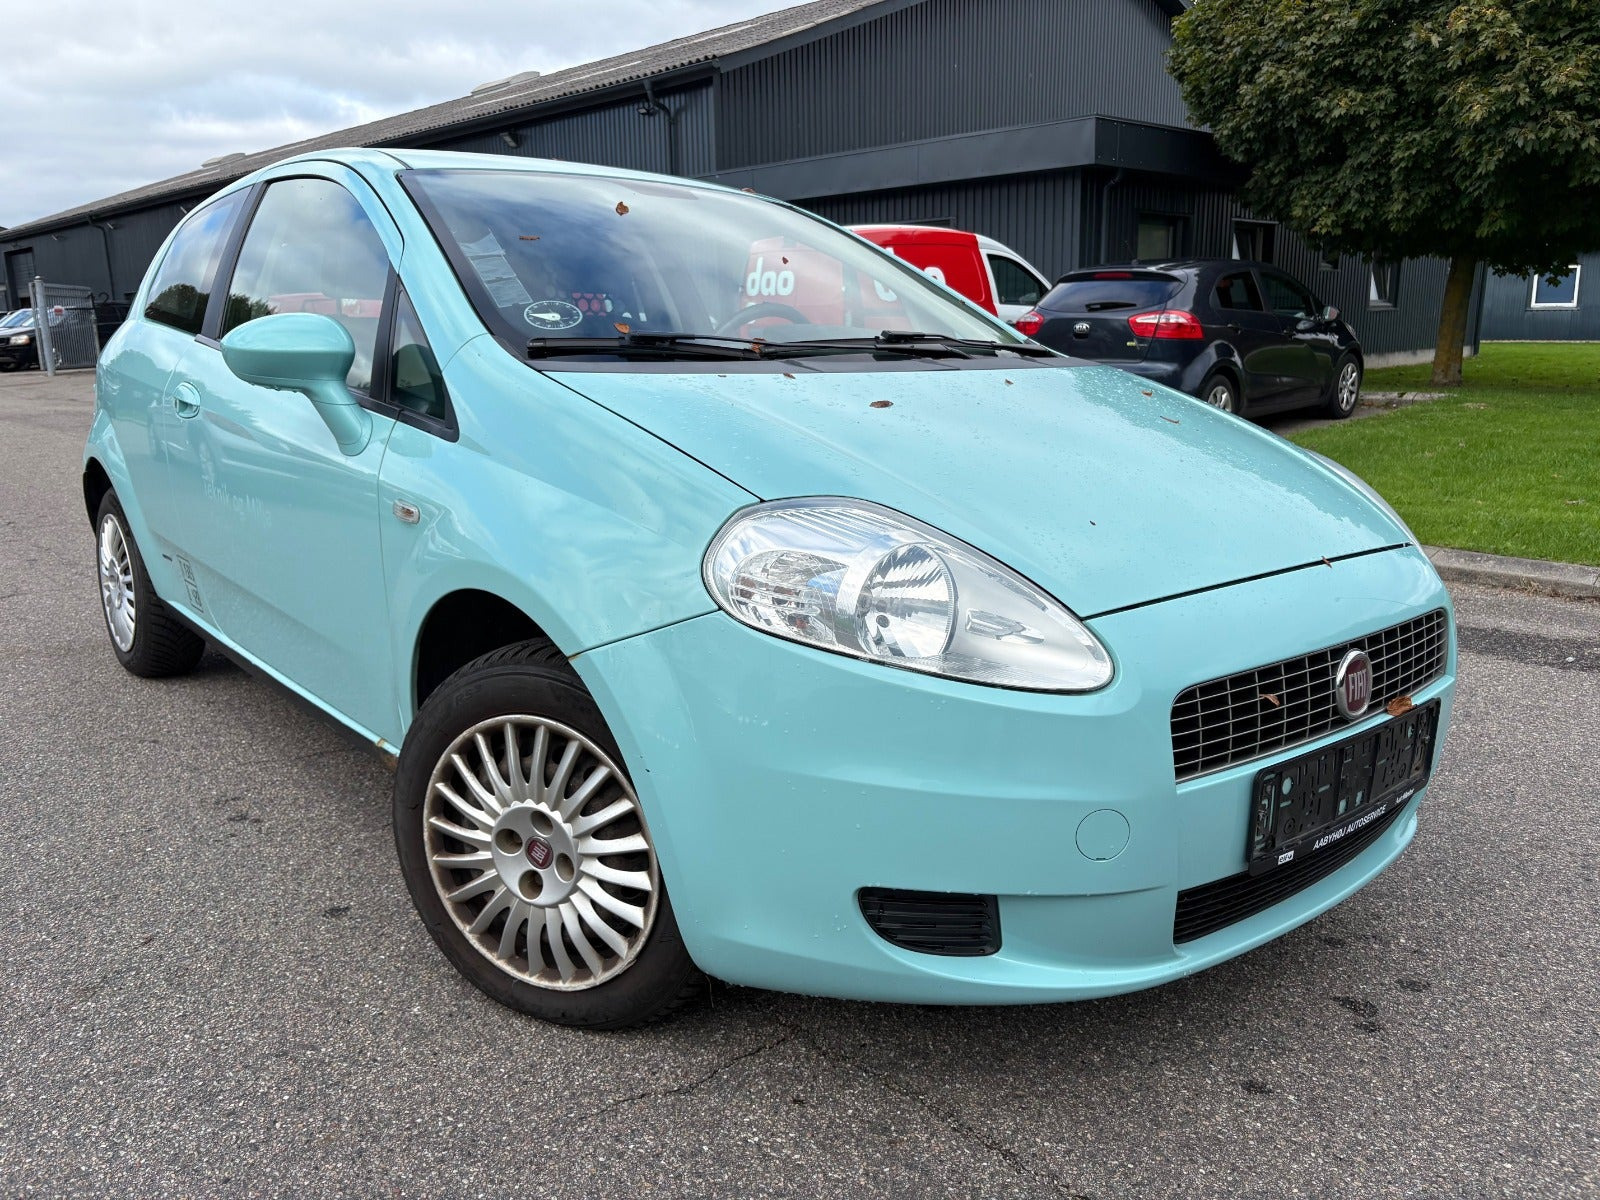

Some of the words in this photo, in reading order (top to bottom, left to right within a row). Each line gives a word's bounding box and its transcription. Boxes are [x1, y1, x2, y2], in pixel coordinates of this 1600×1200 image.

[746, 256, 795, 297] dao
[1348, 668, 1367, 703] FIAT
[1345, 804, 1388, 835] AUTOSERVICE
[530, 841, 549, 864] FIAT
